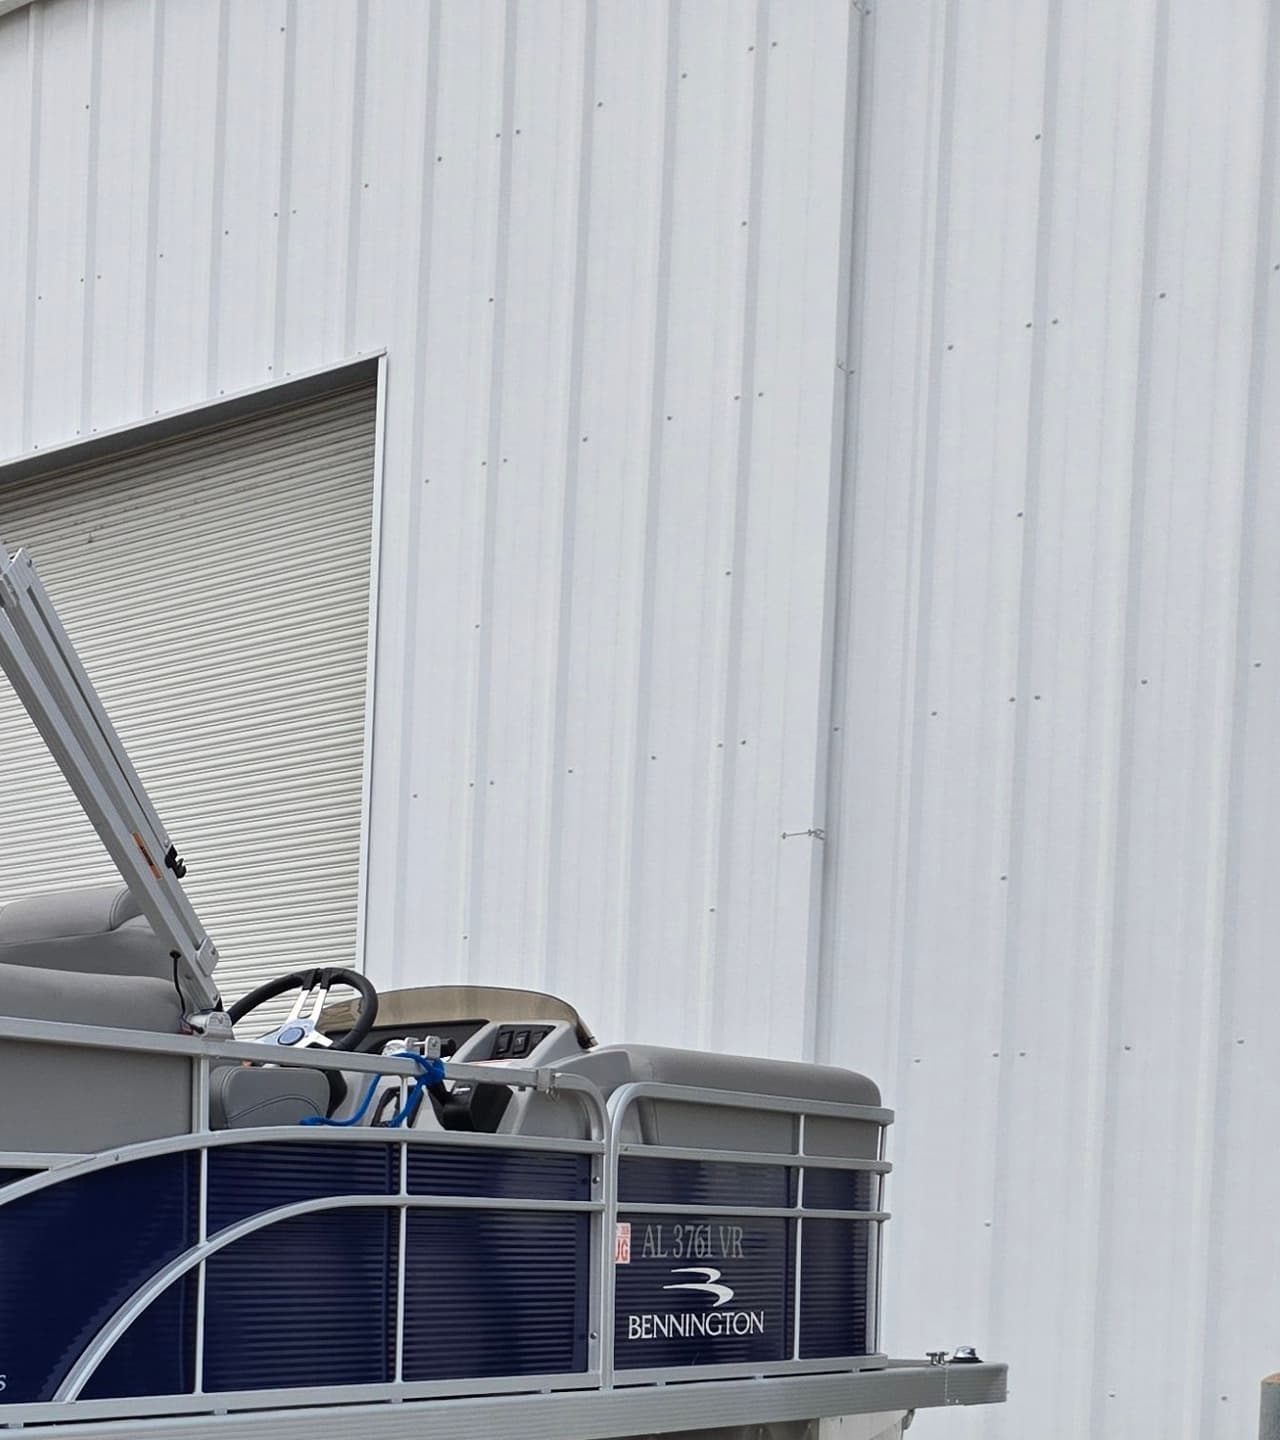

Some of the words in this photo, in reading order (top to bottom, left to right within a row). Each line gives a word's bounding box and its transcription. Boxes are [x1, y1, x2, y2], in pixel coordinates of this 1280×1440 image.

[641, 1224, 668, 1258] AL
[672, 1224, 713, 1258] 3761
[719, 1225, 744, 1258] VR
[628, 1311, 765, 1339] BENNINGTON
